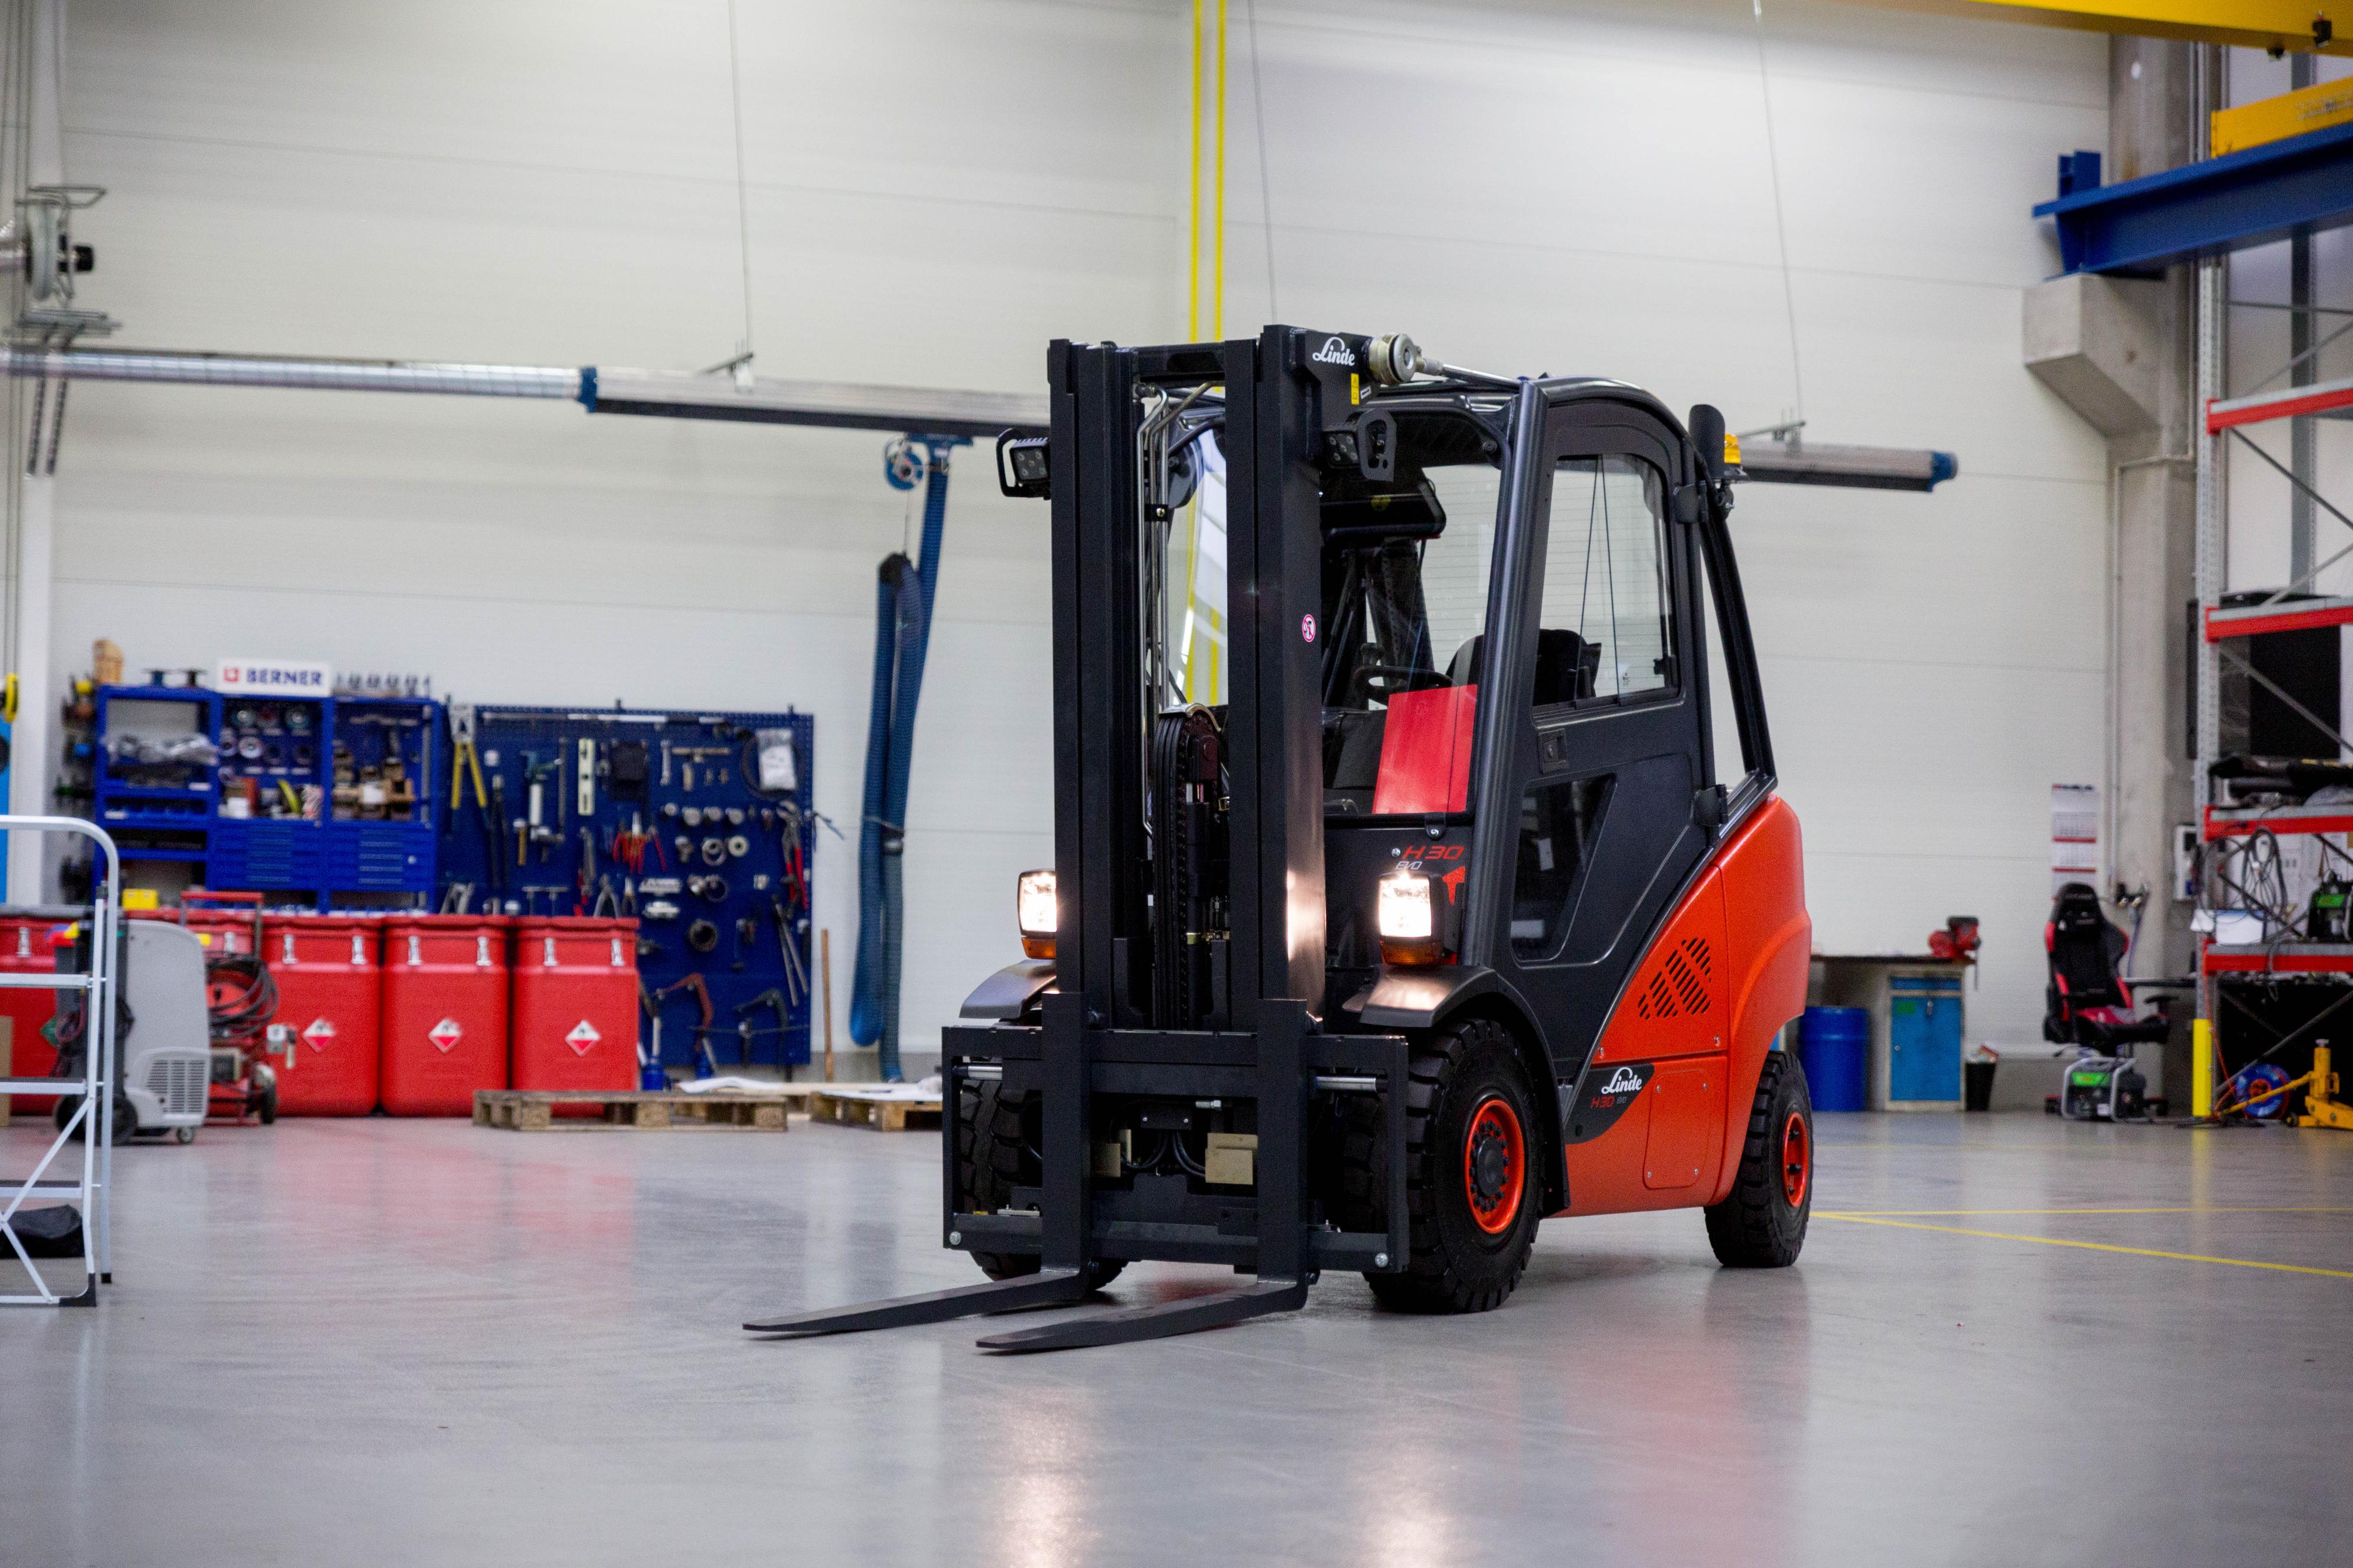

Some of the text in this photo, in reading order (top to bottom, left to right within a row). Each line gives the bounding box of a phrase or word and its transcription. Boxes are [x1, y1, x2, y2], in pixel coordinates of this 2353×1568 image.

[1312, 336, 1355, 366] Linde
[246, 668, 322, 685] BERNER
[1395, 860, 1423, 870] EVO
[1601, 1067, 1642, 1095] Linde
